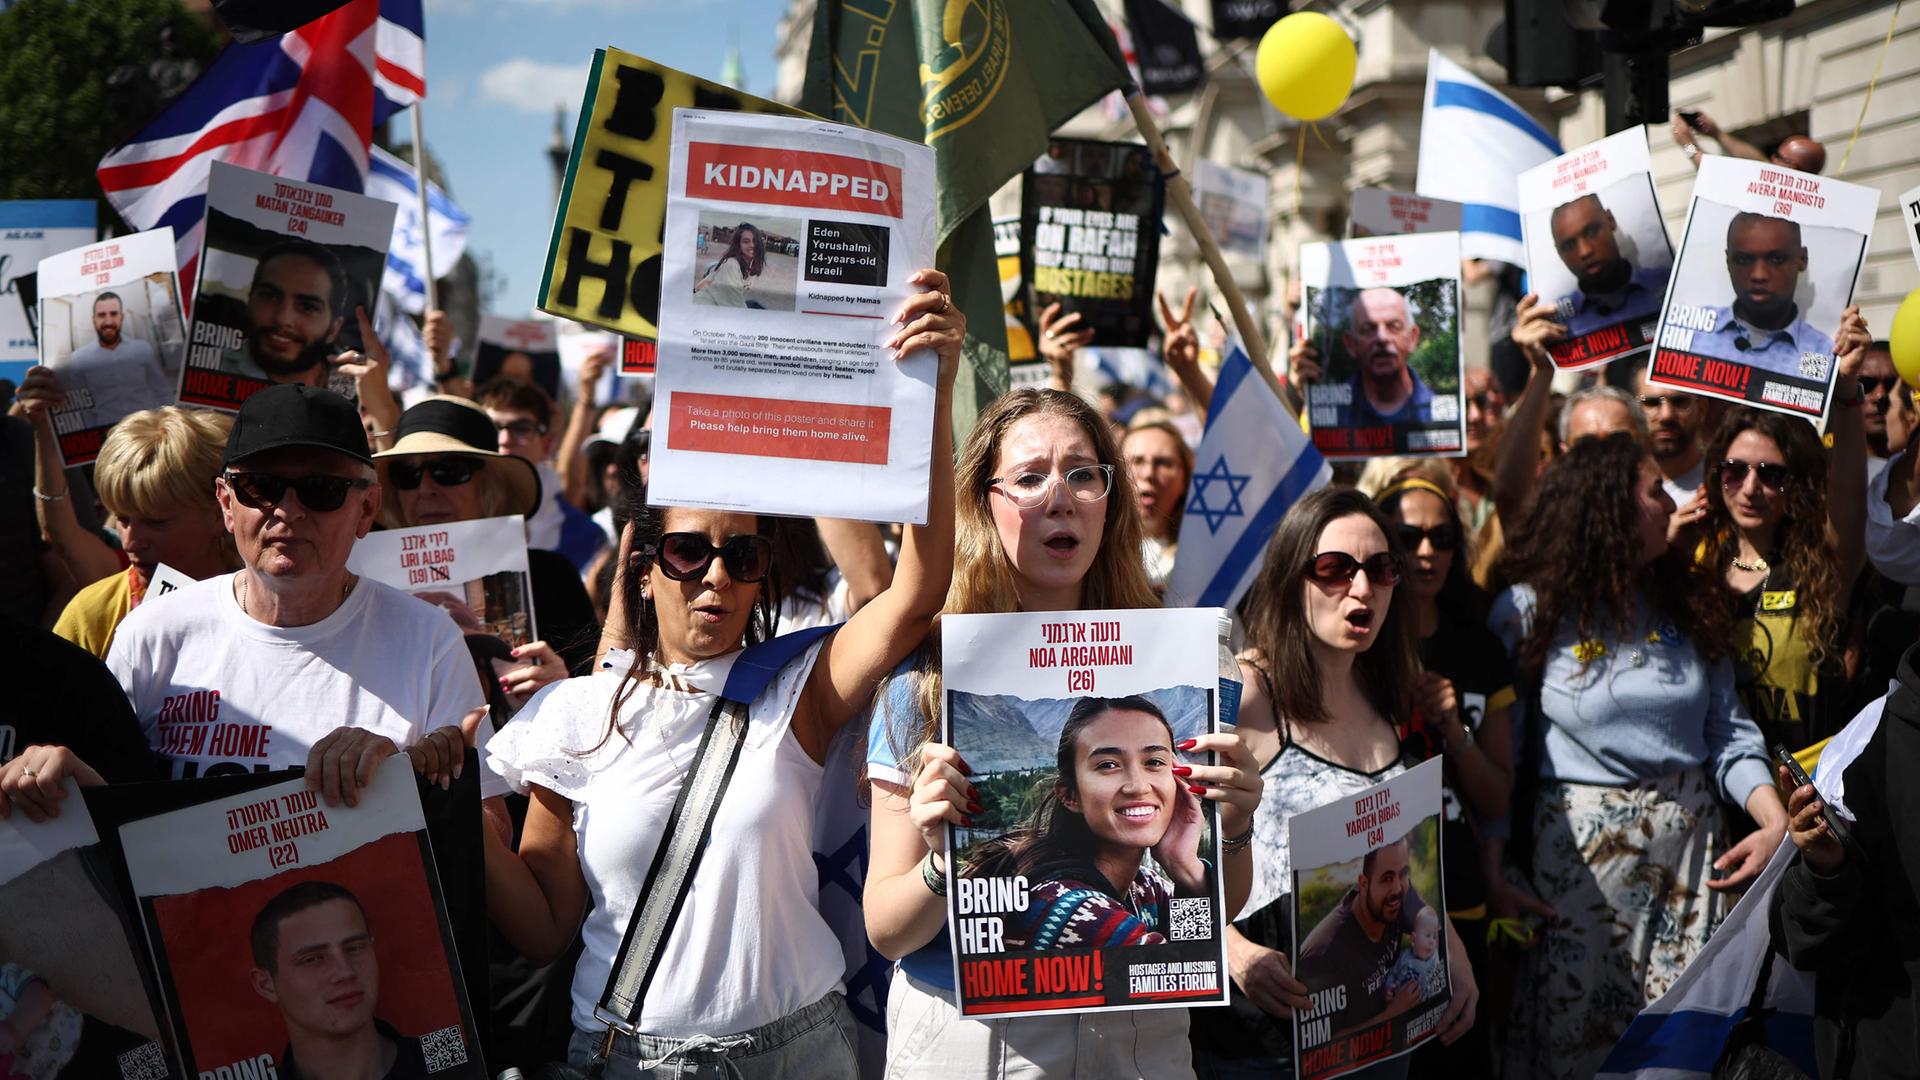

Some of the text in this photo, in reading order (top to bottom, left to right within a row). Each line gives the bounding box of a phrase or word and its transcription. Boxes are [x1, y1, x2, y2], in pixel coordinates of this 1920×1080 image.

[704, 162, 889, 202] KIDNAPPED
[1747, 182, 1825, 209] AVERA MANGISTO
[256, 194, 345, 227] MATAN ZANGAUKER
[1773, 200, 1793, 217] (36)
[288, 217, 308, 235] (24)
[813, 227, 840, 238] Eden
[813, 240, 871, 253] Yerushalmi
[1036, 223, 1065, 251] ON
[1068, 225, 1138, 258] RAFAH
[810, 265, 842, 276] Israeli
[811, 252, 877, 266] 24-years-old
[1035, 266, 1134, 299] HOSTAGES
[808, 292, 881, 305] Kidnapped by Hamas
[1665, 303, 1717, 334] BRING
[193, 320, 244, 350] BRING
[703, 330, 726, 338] October
[1586, 323, 1629, 355] NOW!
[1660, 323, 1695, 352] HIM
[189, 344, 223, 370] HIM
[792, 355, 818, 363] children,
[819, 357, 841, 365] ranging
[747, 366, 777, 374] separated
[1655, 350, 1751, 390] HOME NOW!
[184, 370, 232, 399] HOME
[1310, 382, 1352, 406] BRING
[55, 411, 86, 435] HIM
[687, 405, 875, 429] Take a photo of this poster and share it
[1311, 405, 1338, 427] HIM
[690, 420, 869, 442] Please help bring them home alive.
[429, 531, 449, 547] לירי
[400, 547, 455, 568] LIRI ALBAG
[409, 567, 429, 585] (19)
[1041, 621, 1121, 644] נועה ארגמני
[1029, 645, 1133, 668] NOA ARGAMANI
[1068, 669, 1095, 693] (26)
[158, 690, 220, 725] BRING
[157, 723, 272, 757] THEM HOME
[226, 789, 319, 831] עומר נאוטרה
[1345, 801, 1401, 838] YARDEN BIBAS
[228, 810, 329, 854] OMER NEUTRA
[1367, 826, 1384, 848] (34)
[269, 841, 300, 869] (22)
[957, 875, 1029, 914] BRING
[959, 916, 1006, 954] HER
[963, 950, 1104, 998] HOME NOW!
[1129, 961, 1217, 977] HOSTAGES AND MISSING
[1130, 973, 1217, 994] FAMILIES FORUM
[1301, 1016, 1331, 1050] HIM
[1301, 1020, 1392, 1073] HOME NOW!
